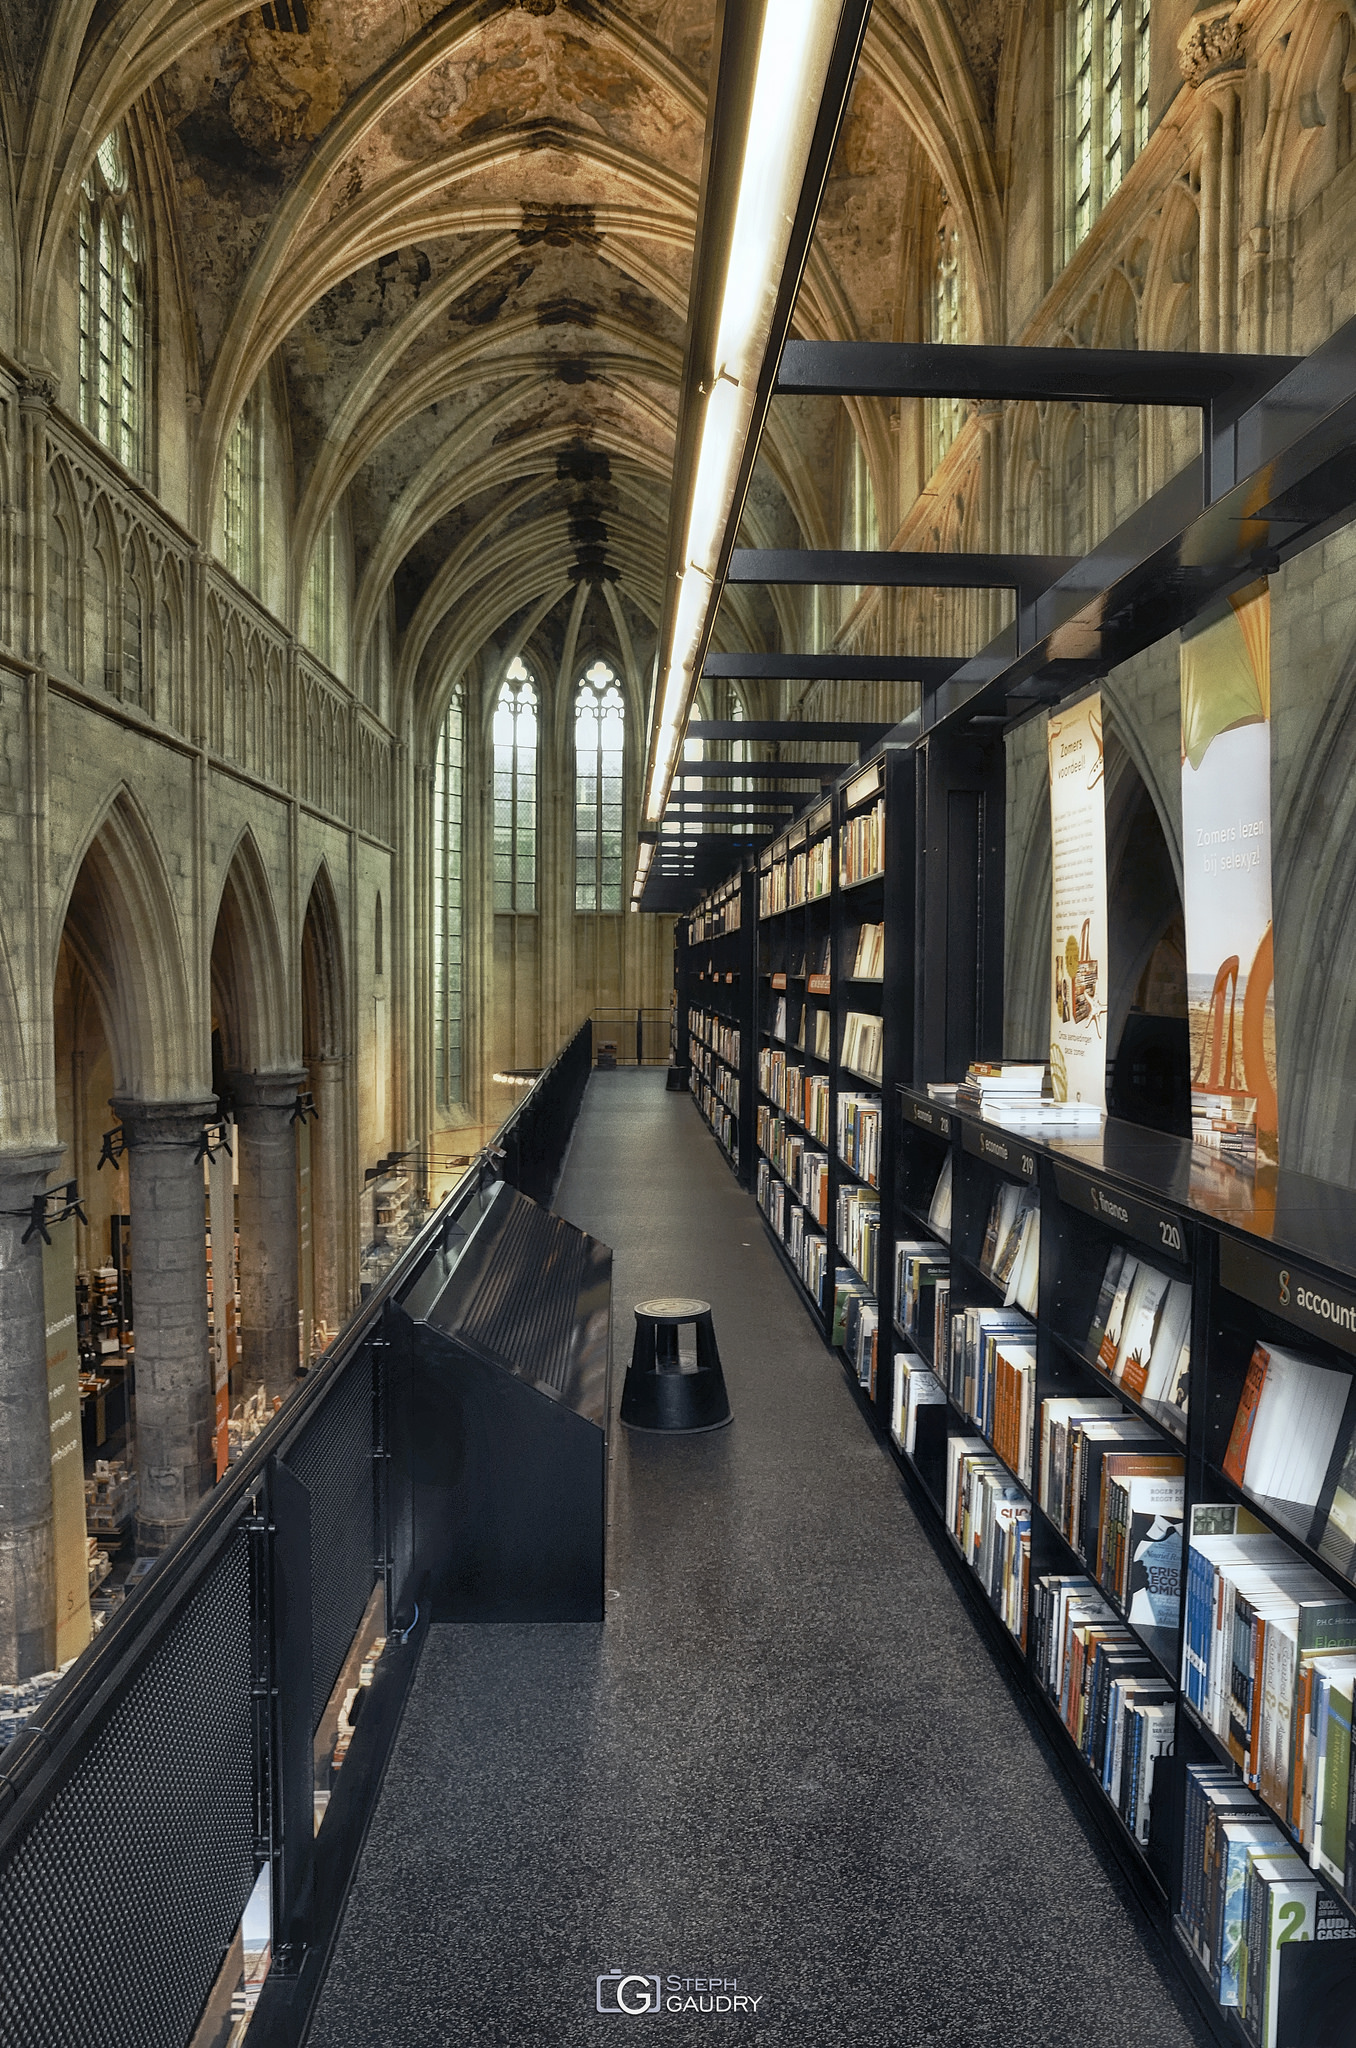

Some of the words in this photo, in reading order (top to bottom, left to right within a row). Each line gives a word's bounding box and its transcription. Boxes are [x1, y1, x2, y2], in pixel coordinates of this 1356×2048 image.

[1060, 738, 1083, 758] Zomers
[1196, 827, 1236, 847] Zomers
[1239, 819, 1264, 839] lezen
[1203, 853, 1217, 876] bij
[1221, 845, 1260, 873] selexyz!
[985, 1138, 1009, 1160] economie
[1021, 1154, 1034, 1175] 219
[1099, 1191, 1129, 1223] finance
[1159, 1221, 1181, 1250] 220
[1317, 1918, 1351, 1930] AUDI
[1317, 1928, 1356, 1941] CASES
